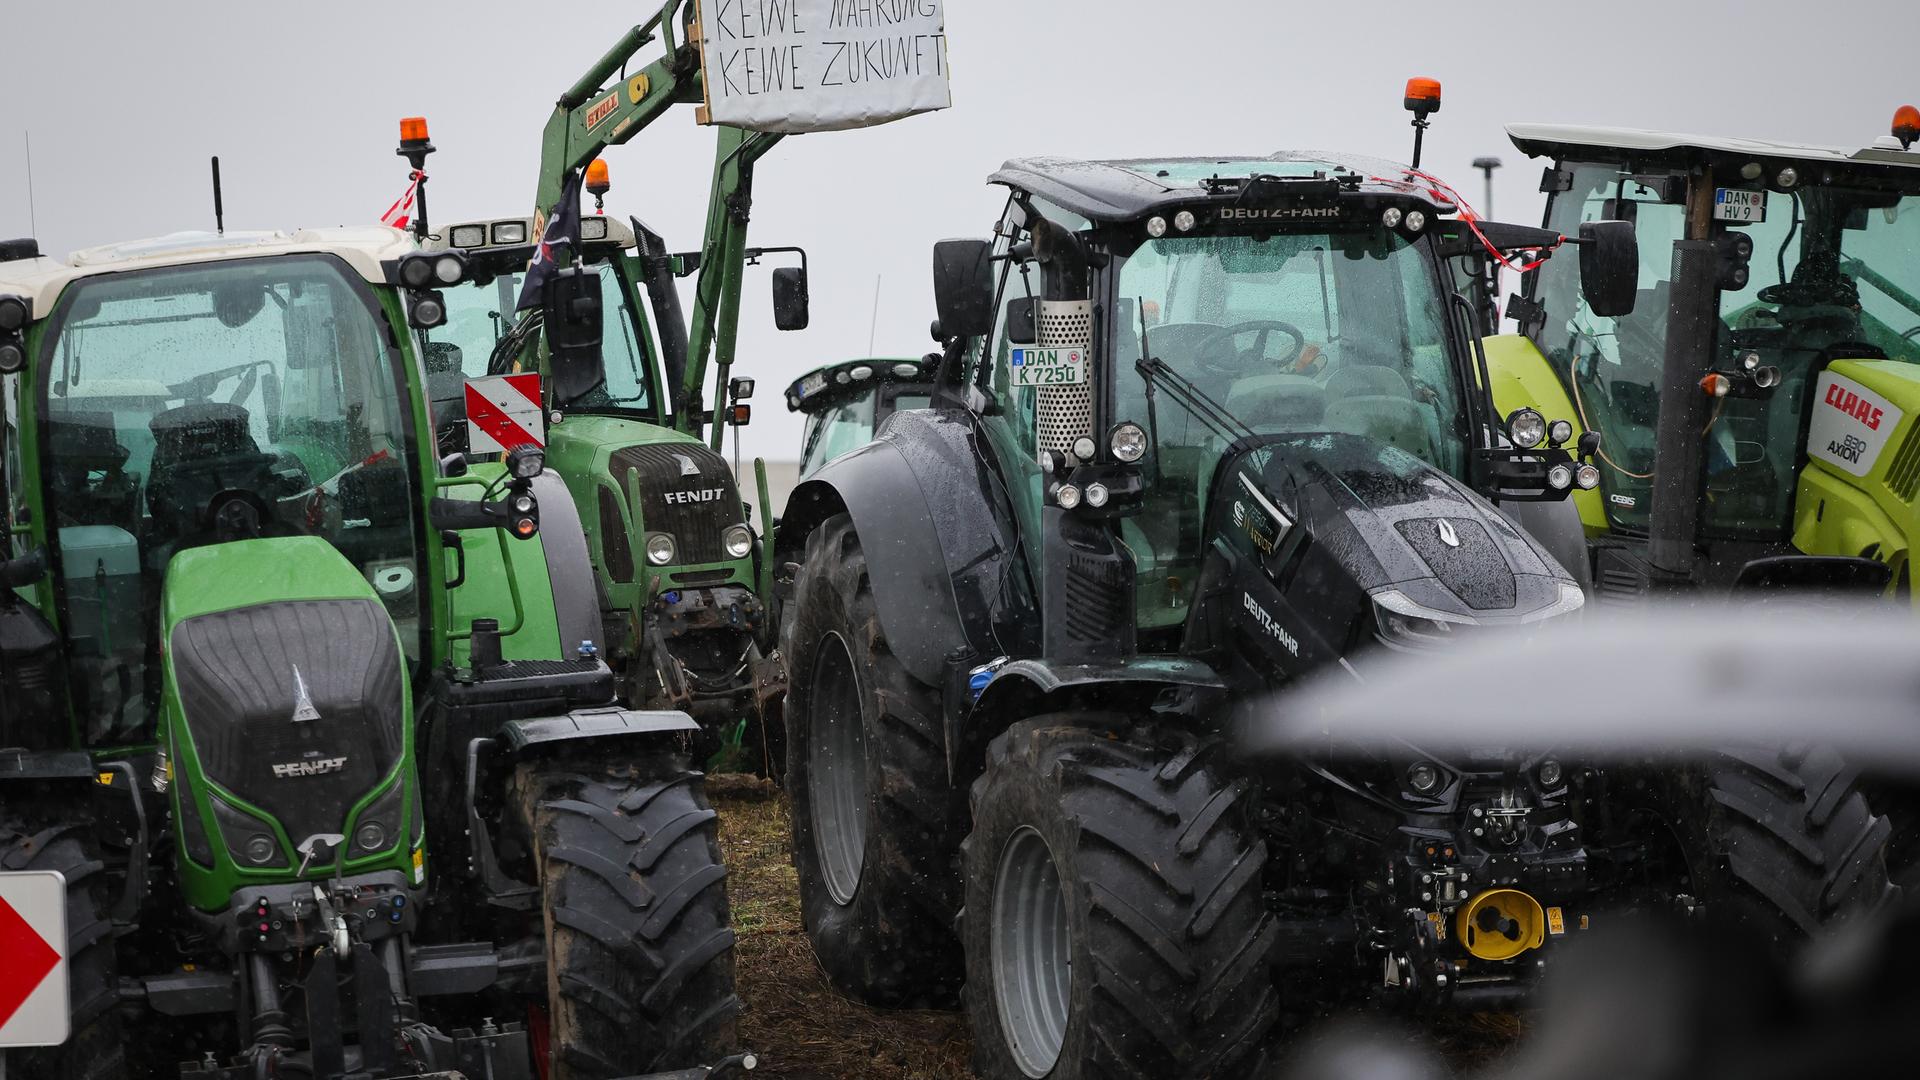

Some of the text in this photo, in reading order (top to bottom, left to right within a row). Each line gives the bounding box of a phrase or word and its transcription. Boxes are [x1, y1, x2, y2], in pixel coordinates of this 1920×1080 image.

[715, 0, 805, 41] KEINE
[719, 35, 944, 97] KEINE ZUKUNFT
[1725, 191, 1749, 206] DAN
[1220, 206, 1340, 219] DEUTZ-FAHR
[1724, 206, 1751, 220] HV 9
[1025, 350, 1058, 366] DAN
[1019, 366, 1076, 384] K 7250
[1824, 383, 1884, 432] CLAAS
[1826, 440, 1860, 464] AXION
[1843, 434, 1867, 454] 830
[663, 488, 724, 505] FENDT
[1610, 494, 1636, 506] CEBIS
[1243, 591, 1299, 658] DEUTZ-FAHR
[272, 757, 348, 778] FENDT
